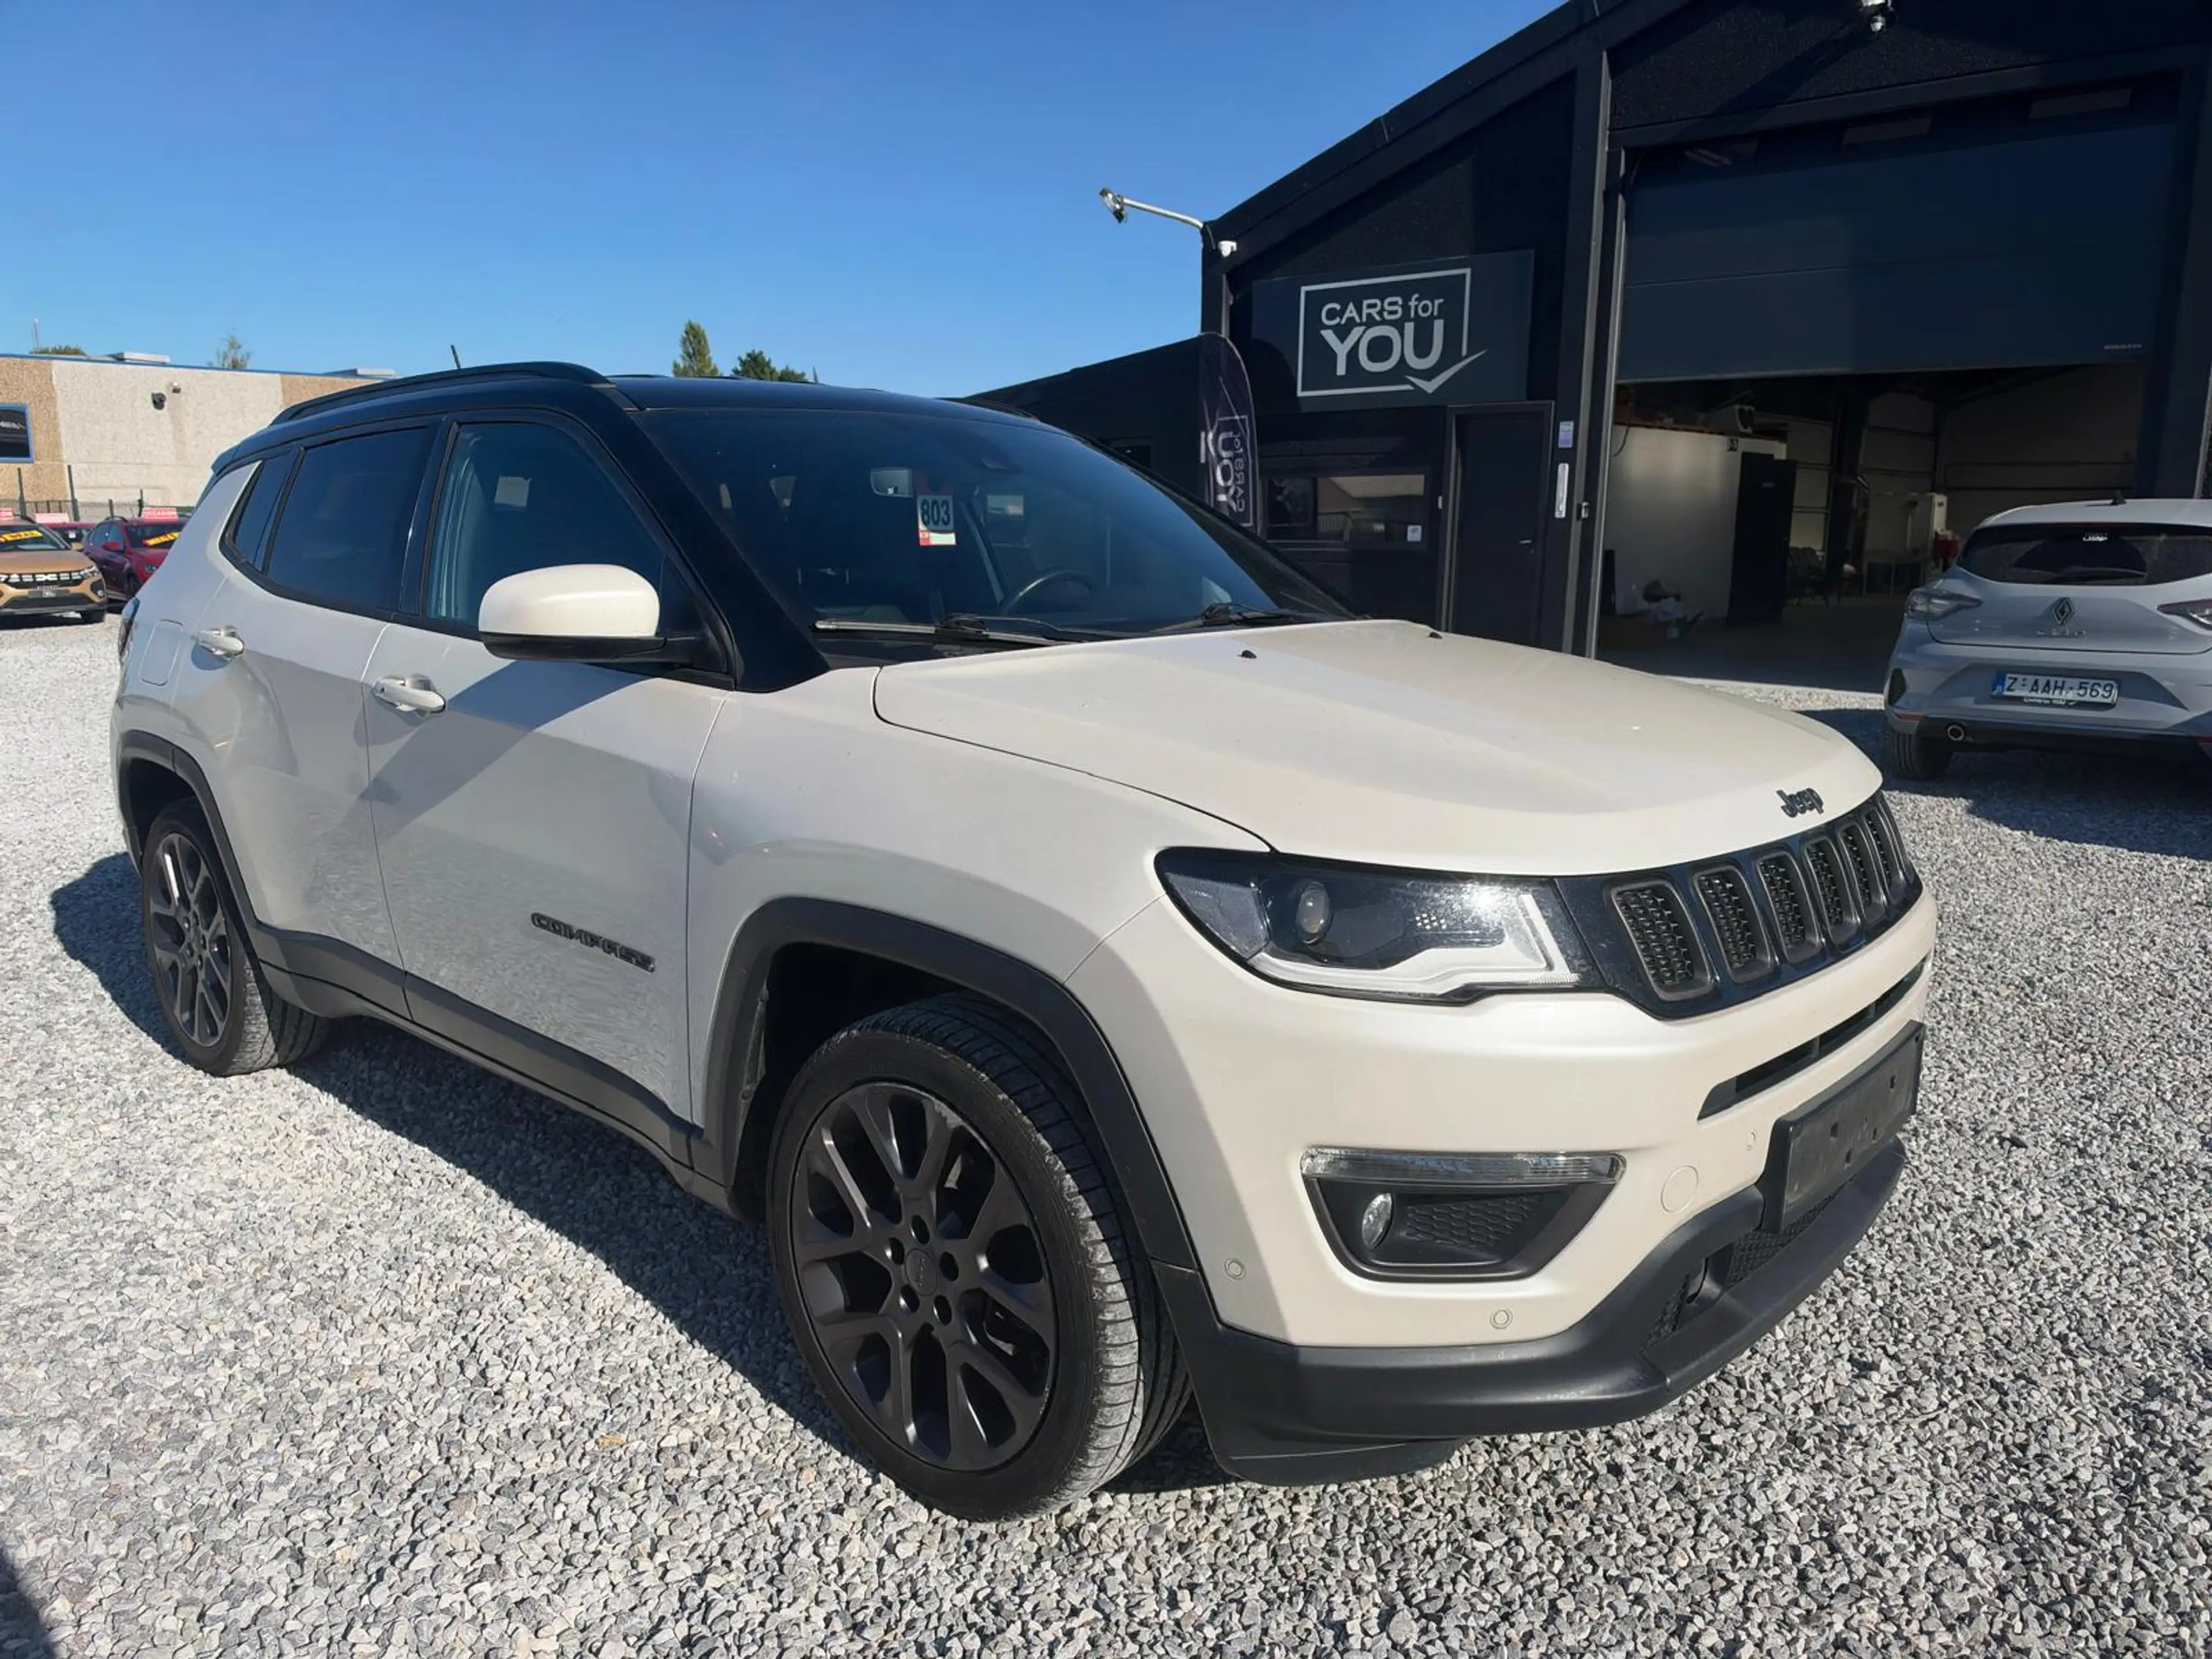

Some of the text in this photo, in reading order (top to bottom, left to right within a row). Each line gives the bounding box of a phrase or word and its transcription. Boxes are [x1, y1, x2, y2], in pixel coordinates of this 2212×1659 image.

[1321, 293, 1444, 325] CARS for
[1320, 319, 1444, 376] YOU
[921, 499, 950, 528] 803
[1775, 787, 1824, 818] Jeep
